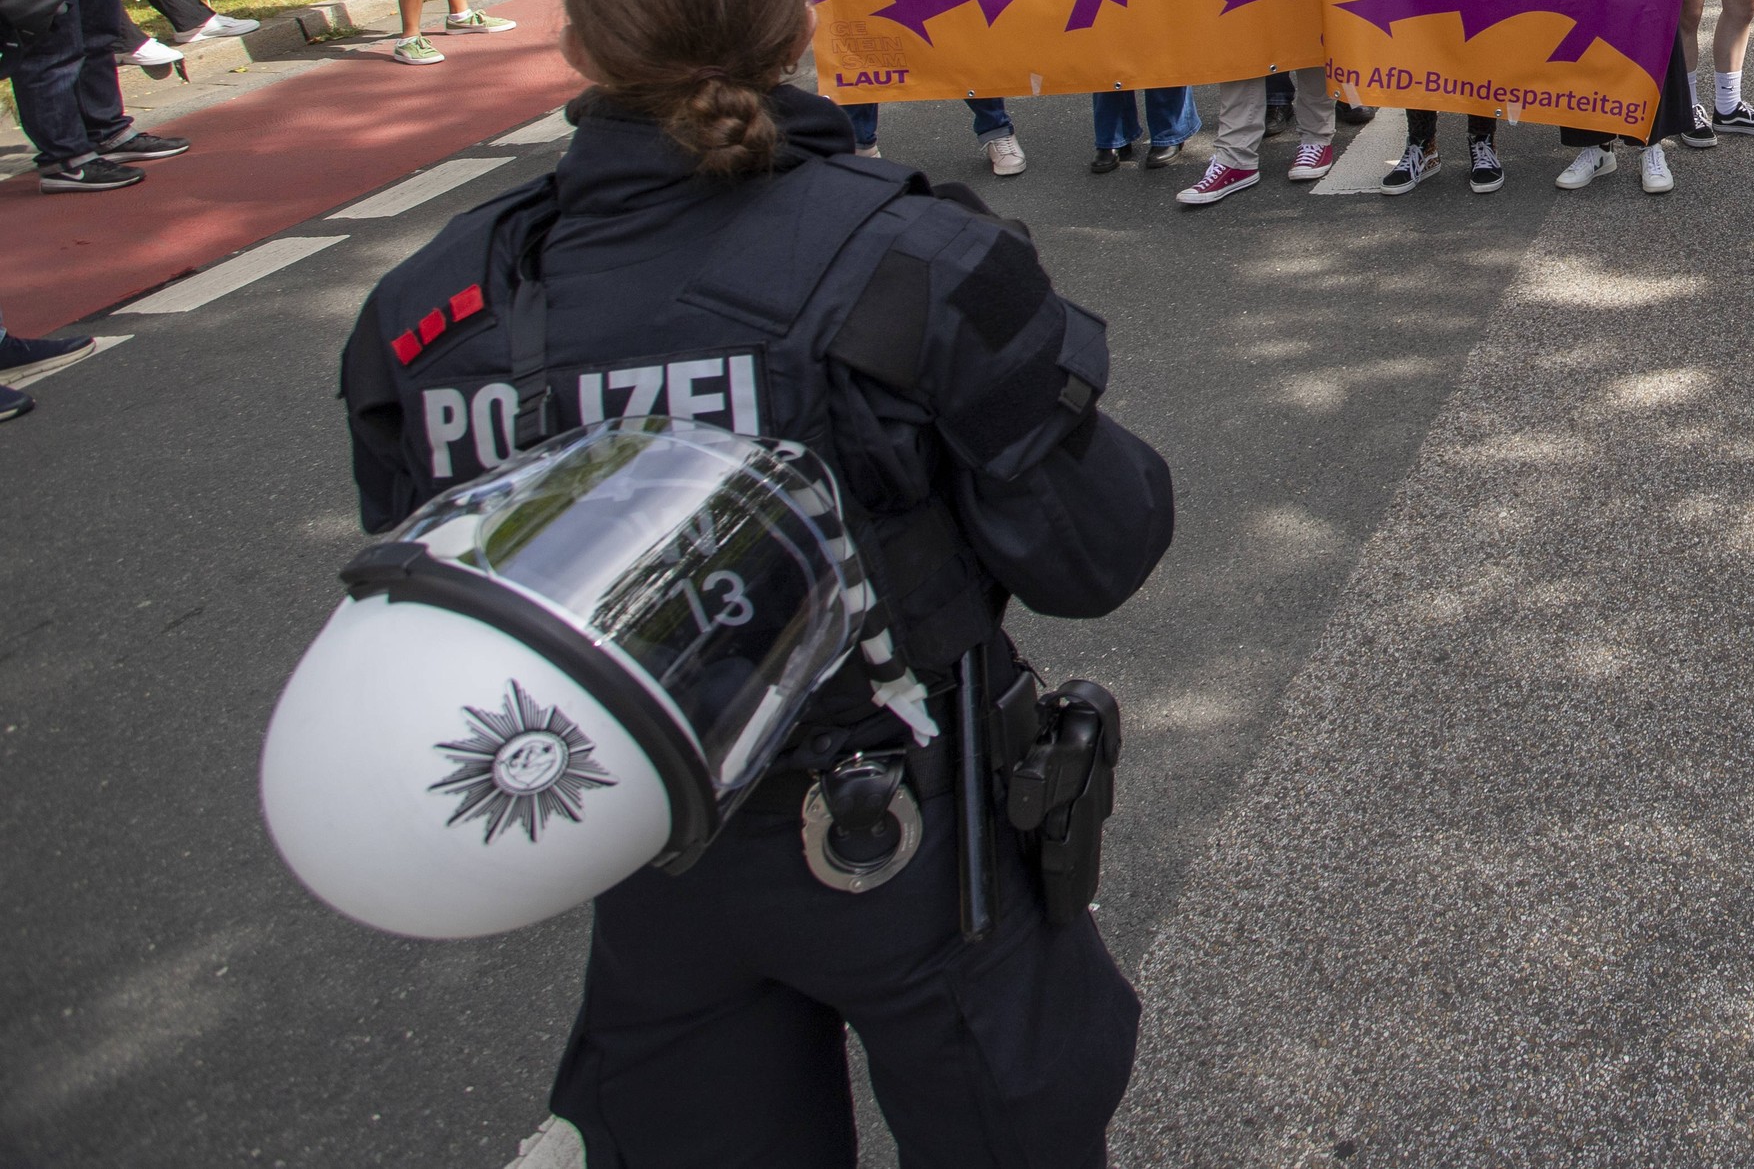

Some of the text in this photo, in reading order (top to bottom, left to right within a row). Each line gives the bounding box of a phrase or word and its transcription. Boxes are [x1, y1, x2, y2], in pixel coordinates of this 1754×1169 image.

[830, 20, 867, 37] GE
[832, 37, 903, 54] MEIN
[842, 53, 907, 70] SAM
[835, 69, 910, 87] LAUT
[1325, 58, 1648, 124] den AfD-Bundesparteitag!
[423, 354, 758, 478] POIZEI
